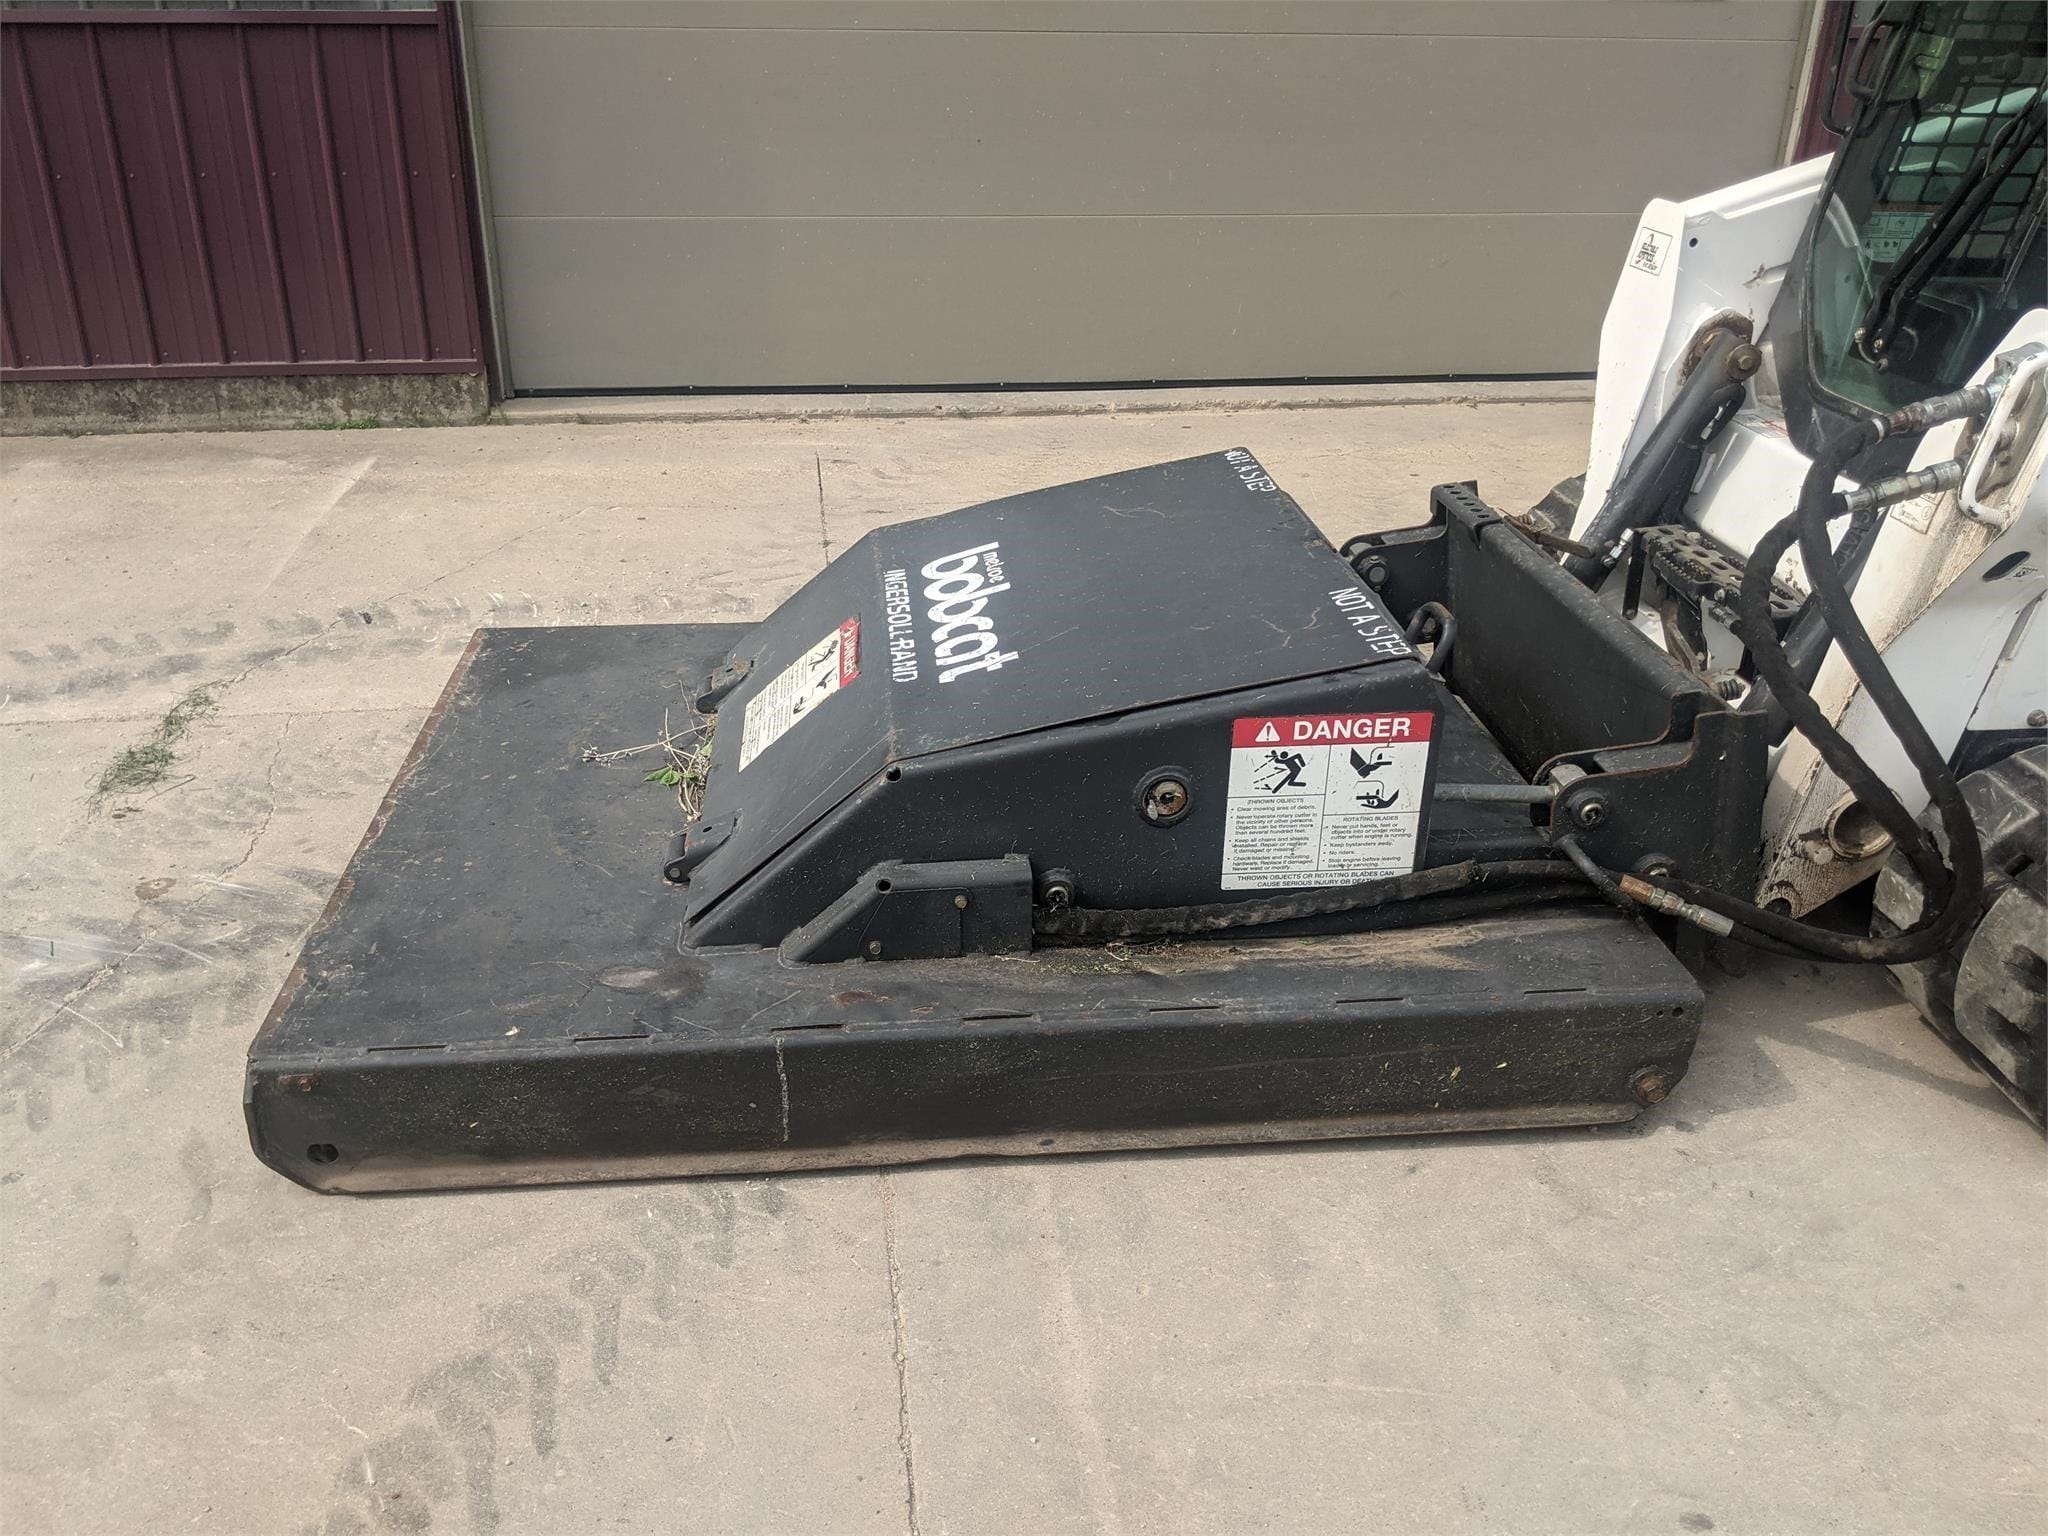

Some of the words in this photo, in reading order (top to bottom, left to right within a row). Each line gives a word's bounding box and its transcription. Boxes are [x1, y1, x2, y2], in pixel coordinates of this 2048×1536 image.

[1224, 451, 1254, 464] NOT
[1240, 472, 1277, 491] STEP
[921, 542, 1019, 684] bobcat
[1328, 587, 1374, 612] NOT
[1347, 615, 1380, 626] A
[1358, 626, 1412, 655] STEP
[1293, 717, 1411, 740] DANGER
